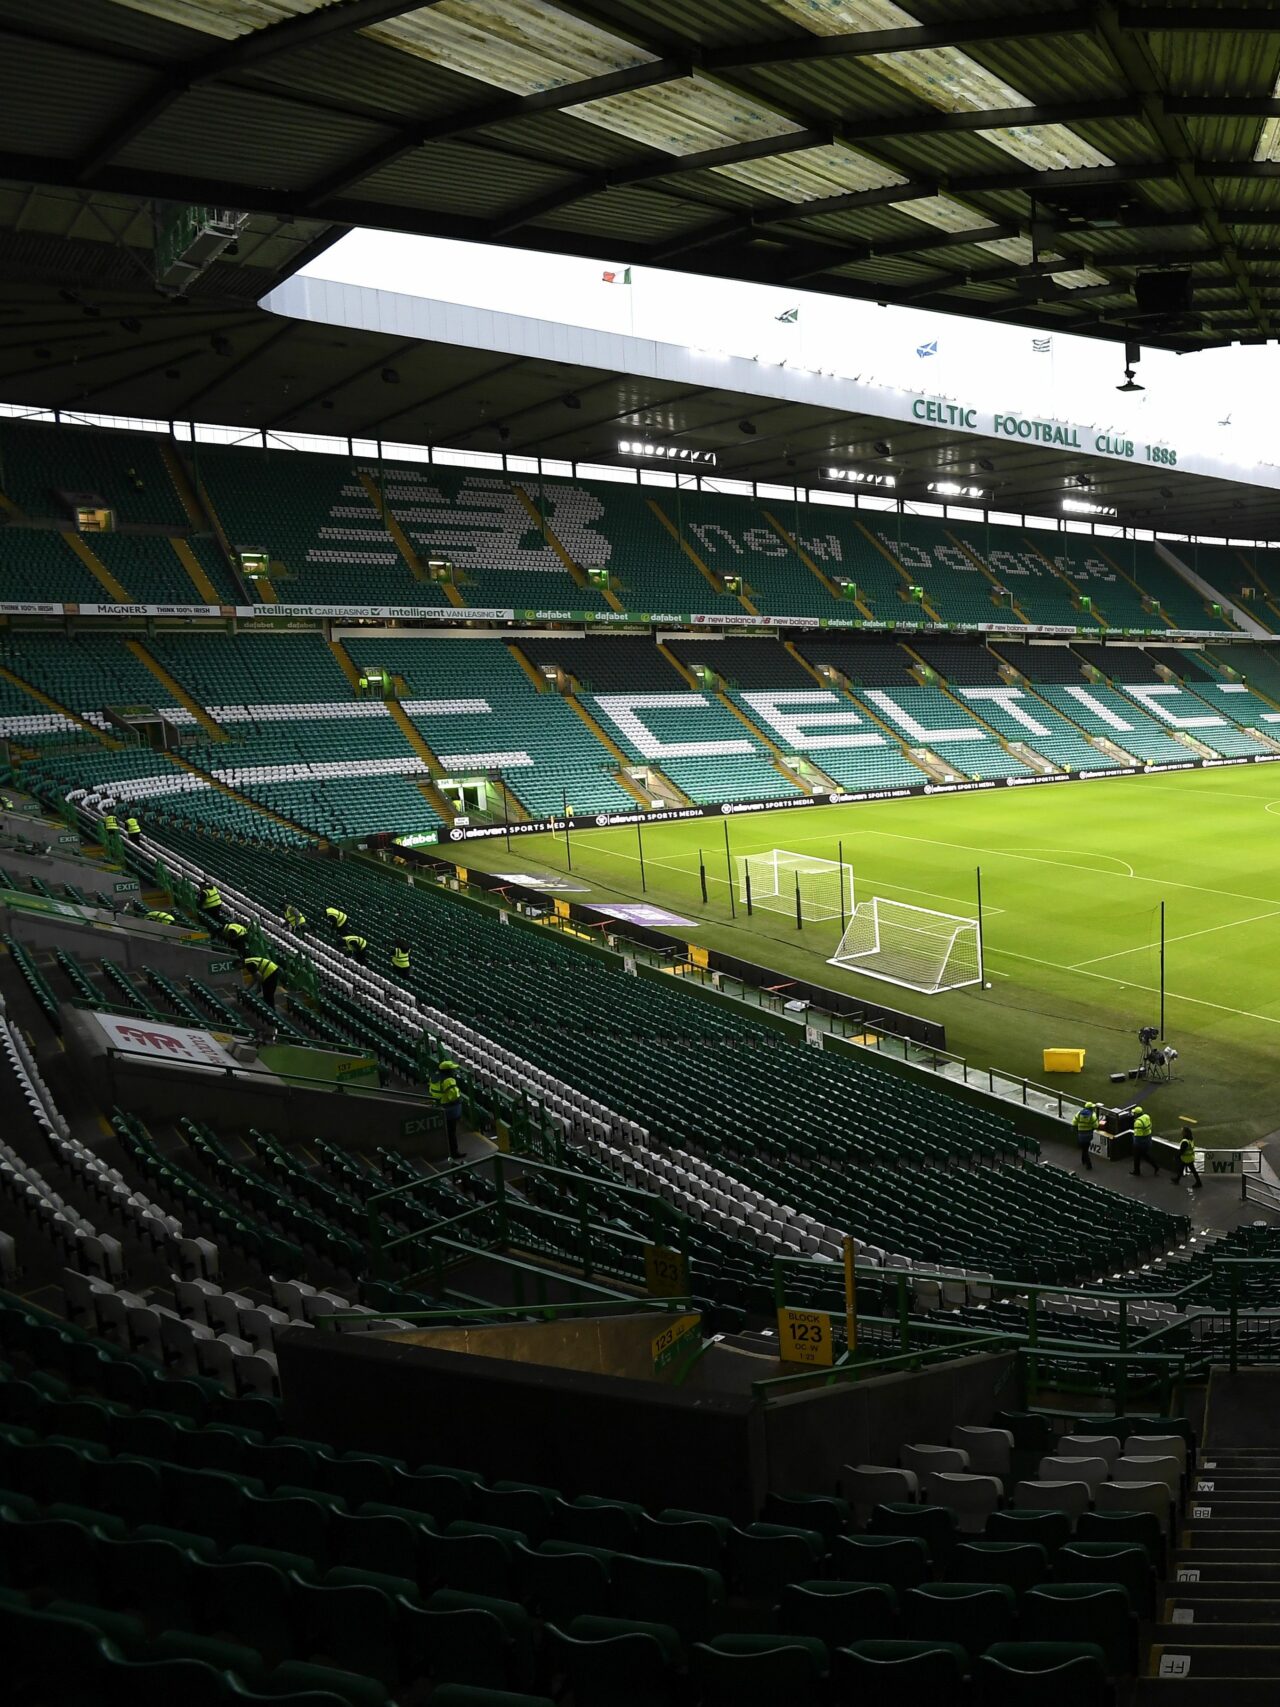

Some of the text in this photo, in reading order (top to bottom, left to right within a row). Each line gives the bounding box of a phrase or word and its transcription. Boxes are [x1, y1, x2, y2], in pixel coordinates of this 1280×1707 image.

[911, 398, 1178, 466] CELTIC FOOTBALL CLUB 1888
[688, 522, 1117, 582] new balance
[97, 604, 148, 613] MAGNERS
[253, 606, 314, 616] ntelligent
[389, 607, 445, 618] intelligent
[536, 610, 571, 619] dafabet
[595, 611, 628, 620] dafabet
[651, 613, 682, 622] dafabet
[725, 616, 756, 624] balance
[789, 618, 818, 626] balance
[828, 619, 853, 627] dafabet
[593, 684, 1228, 757] CELTIC
[958, 782, 978, 790] SPORTS
[979, 780, 995, 788] MEDIA
[868, 791, 891, 799] SPORTS
[892, 789, 911, 797] MEDIA
[765, 801, 792, 809] SPORTS
[793, 799, 815, 807] MEDIA
[647, 811, 677, 821] SPORTS
[679, 808, 704, 818] MEDIA
[509, 823, 544, 834] SPORTS
[547, 820, 575, 831] MEDA
[116, 883, 136, 892] EXIT
[405, 1115, 440, 1135] EXIT
[1212, 1161, 1235, 1173] W1
[653, 1259, 678, 1281] 123
[788, 1312, 820, 1323] BLOCK
[789, 1323, 822, 1343] 123
[655, 1330, 673, 1351] 123
[1194, 1509, 1210, 1518] BB
[1163, 1660, 1185, 1674] FF
